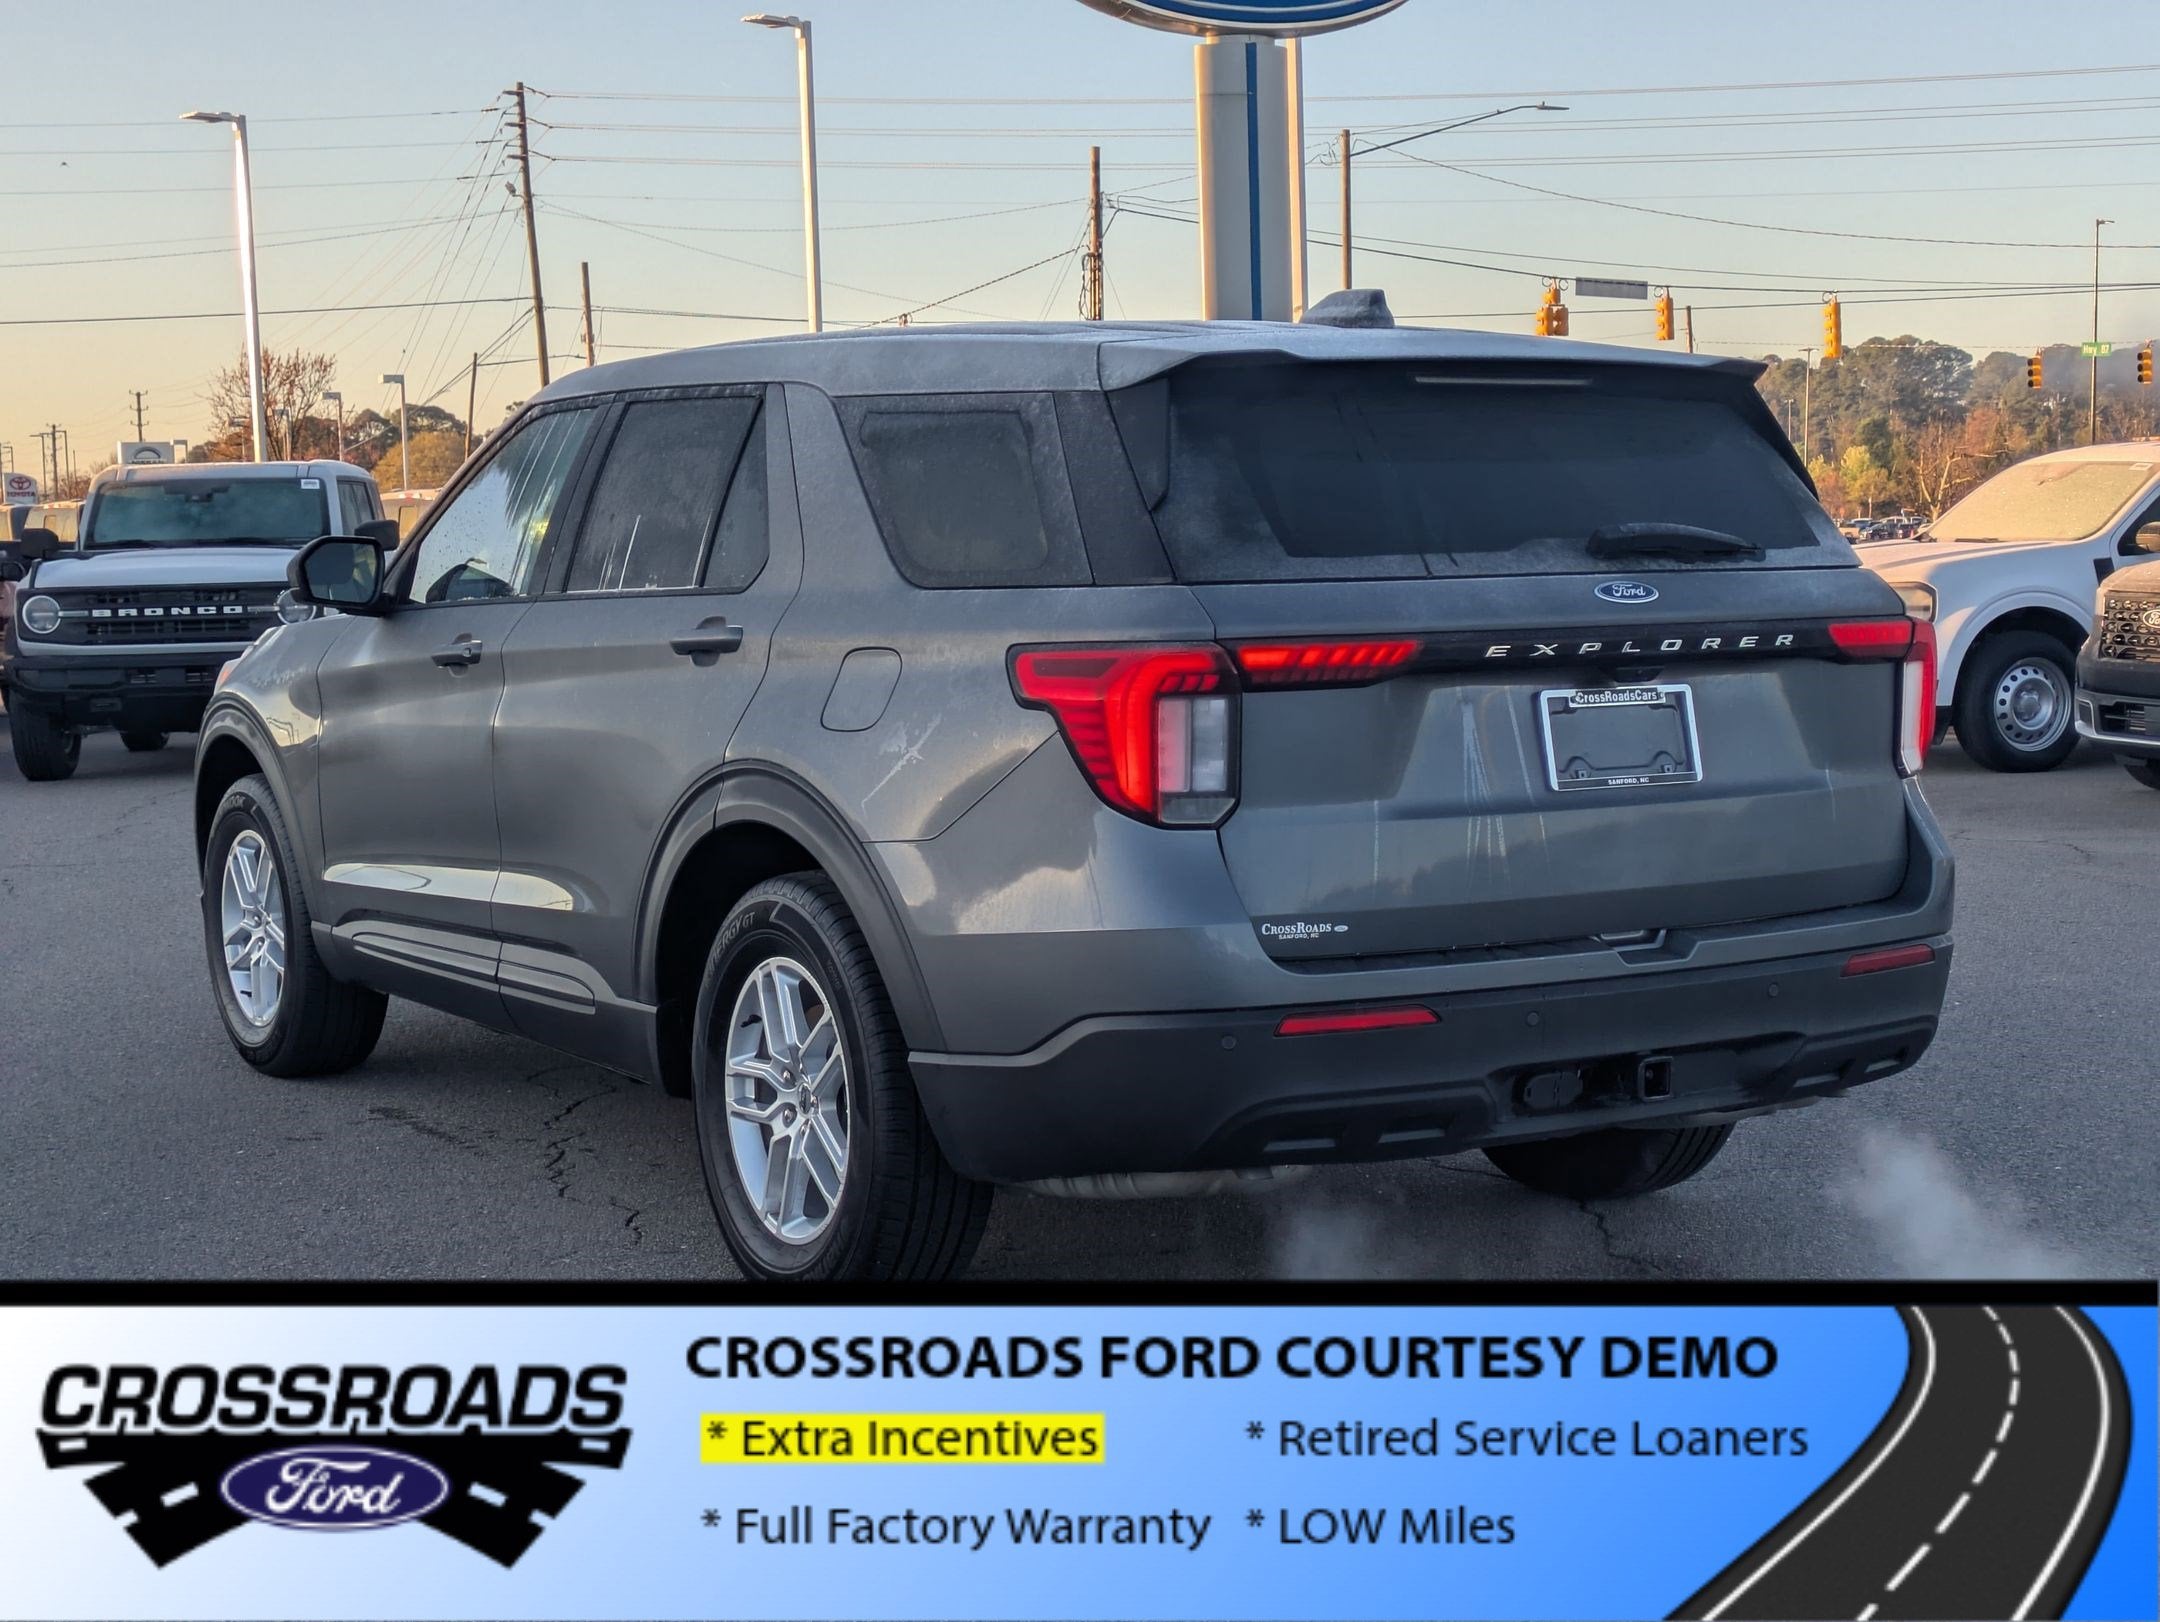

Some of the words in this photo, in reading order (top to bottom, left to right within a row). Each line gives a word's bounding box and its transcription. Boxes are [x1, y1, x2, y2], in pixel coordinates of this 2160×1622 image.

[1611, 583, 1646, 597] Ford
[92, 606, 243, 617] BRONCO
[1484, 634, 1794, 657] EXPLORER
[1577, 690, 1658, 704] CrossRoadsCars
